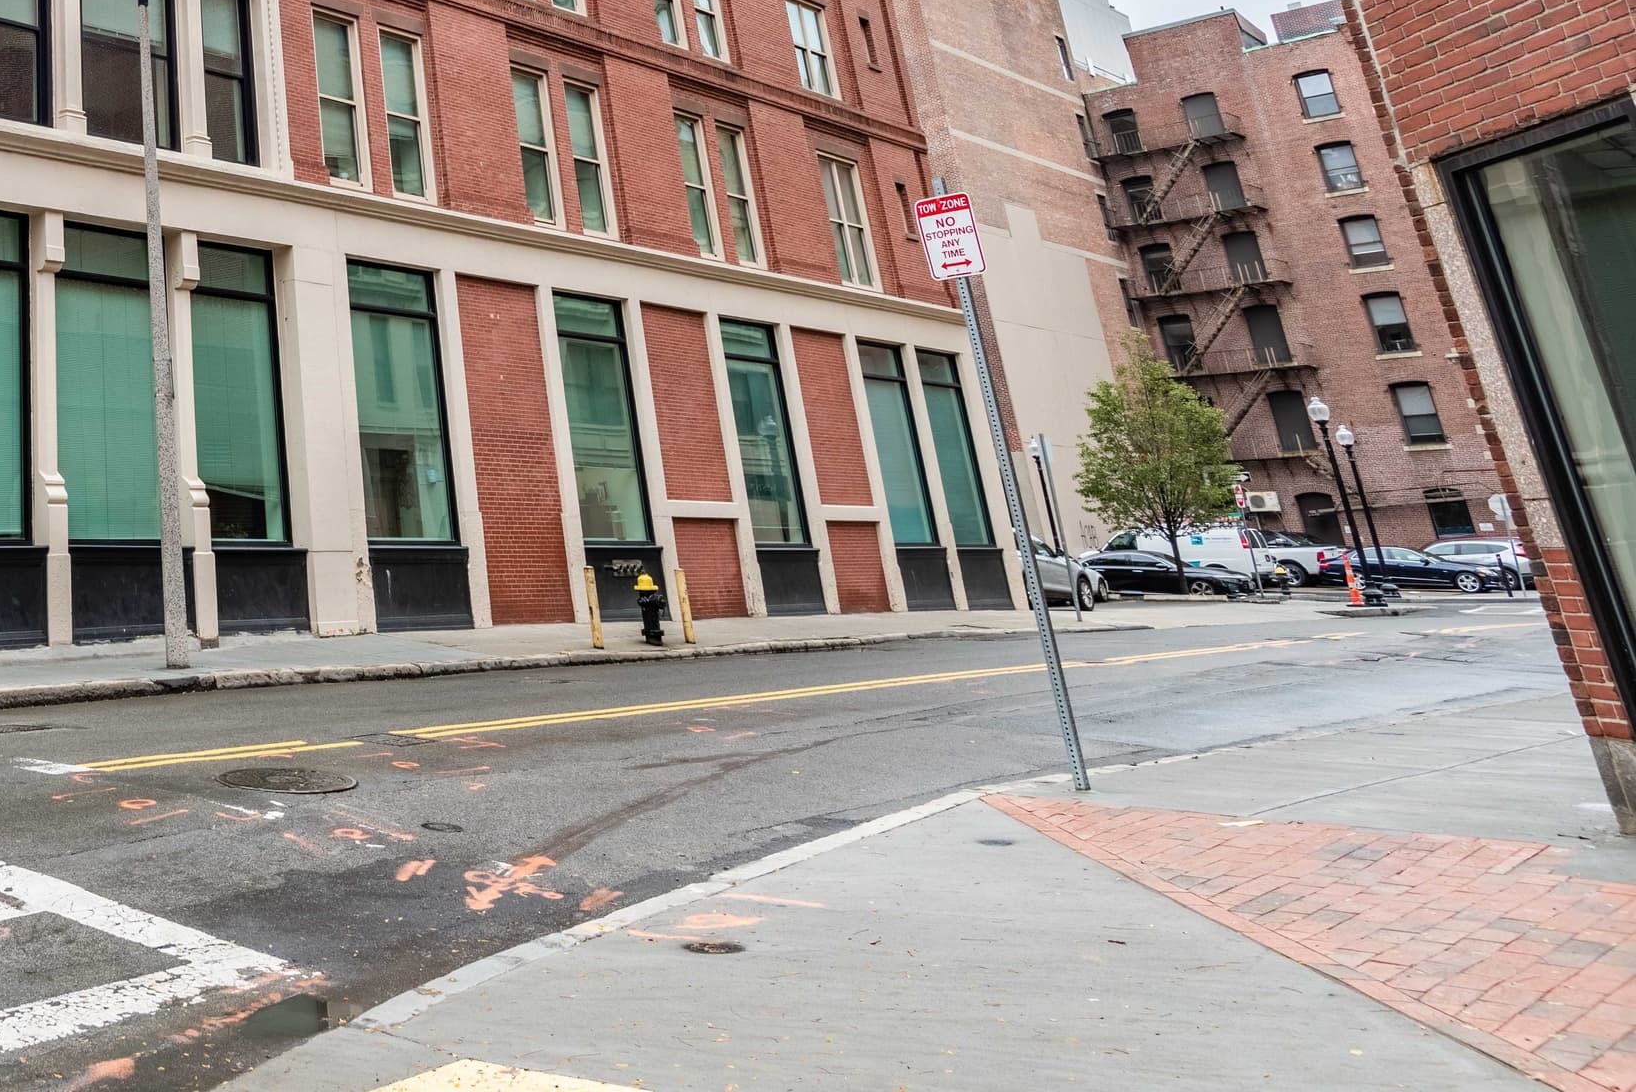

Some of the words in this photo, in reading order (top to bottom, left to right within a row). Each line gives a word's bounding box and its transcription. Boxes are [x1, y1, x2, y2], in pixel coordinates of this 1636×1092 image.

[918, 204, 937, 215] TOW
[939, 197, 968, 210] ZONE
[935, 216, 956, 229] NO
[925, 225, 974, 241] STOPPING
[941, 238, 960, 249] ANY
[941, 248, 966, 259] TIME
